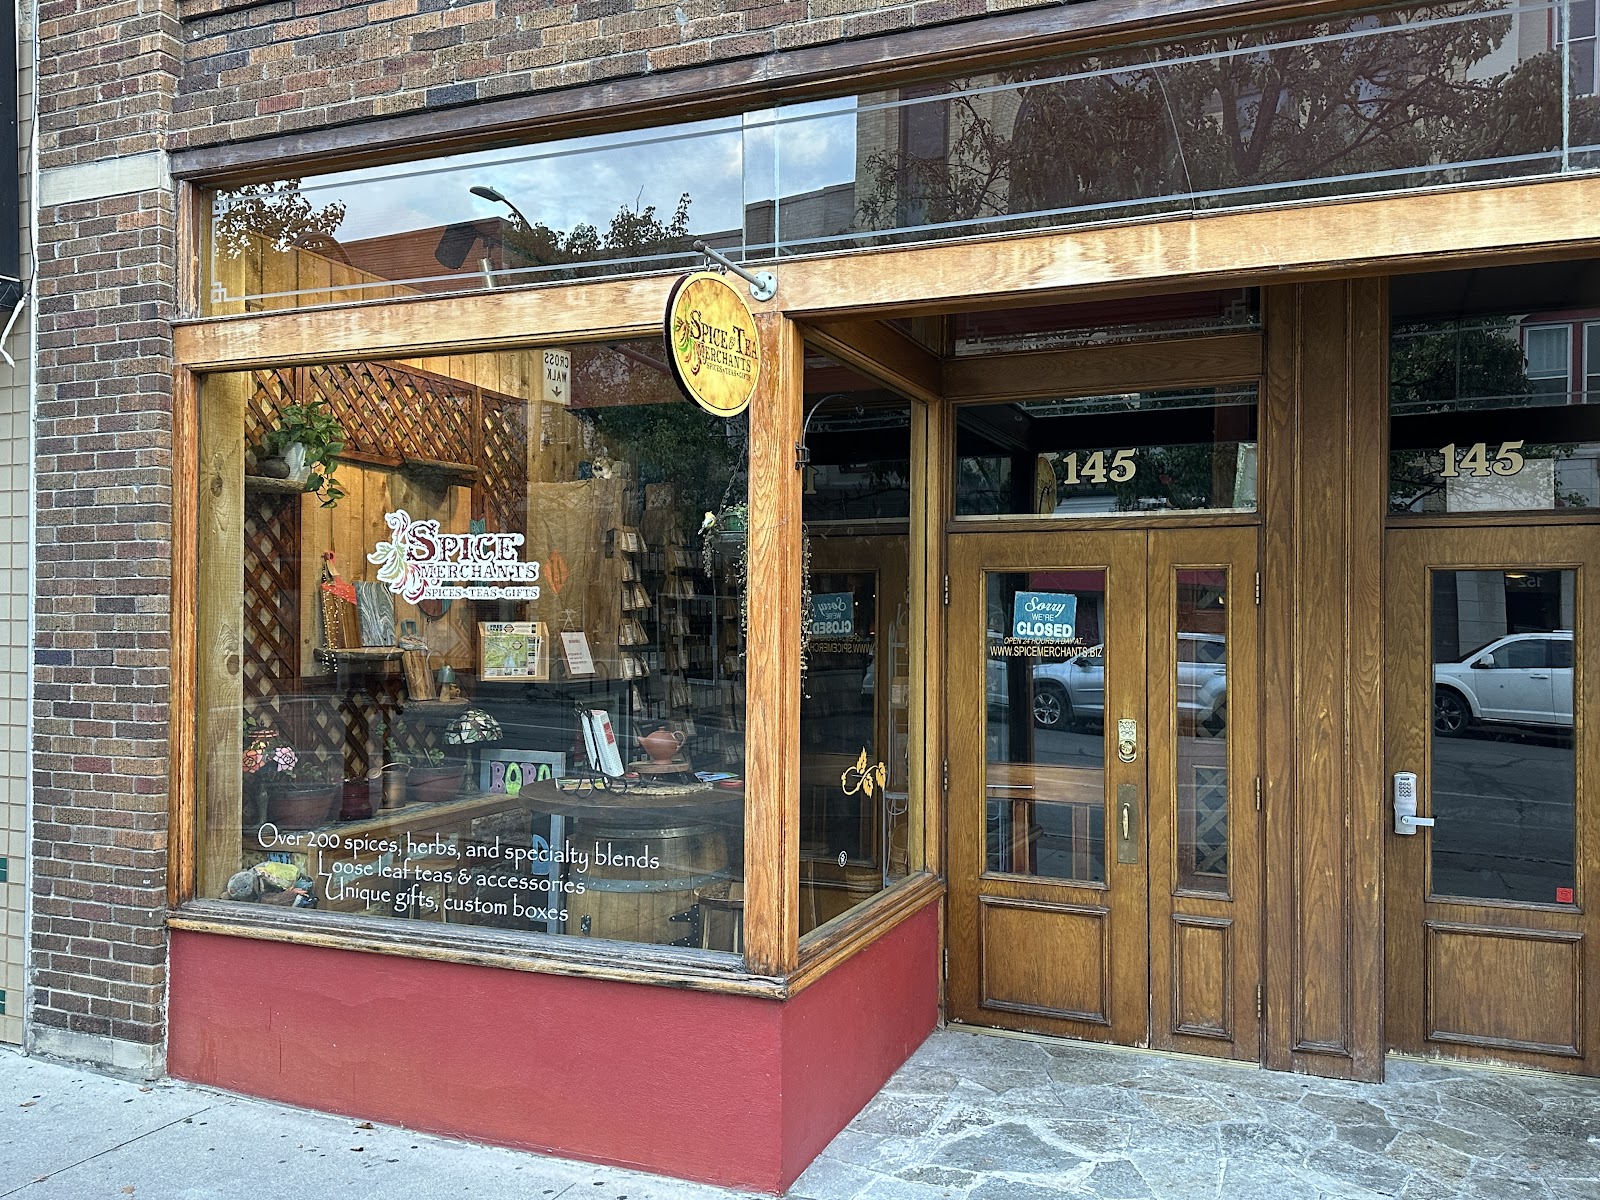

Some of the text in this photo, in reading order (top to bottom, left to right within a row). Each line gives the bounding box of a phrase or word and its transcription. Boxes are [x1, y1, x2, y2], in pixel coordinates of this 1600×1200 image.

[690, 310, 728, 349] SPICE
[733, 325, 758, 360] TEA
[699, 342, 752, 372] MERCHANTS
[1063, 447, 1137, 485] 145
[1439, 440, 1525, 477] 145
[406, 522, 517, 562] SPICE
[420, 563, 538, 580] MERCHANTS
[424, 588, 538, 598] SPICES TEAS GIFTS
[1024, 597, 1066, 618] Sorry
[1016, 621, 1073, 638] CLOSED
[1031, 613, 1054, 622] WE'RE
[990, 645, 1103, 658] WWW.SPICEMERCHANTS.BIZ
[1004, 637, 1022, 645] OPEN
[1022, 637, 1031, 645] 24
[1031, 637, 1055, 645] HOURS
[258, 822, 303, 848] Over
[307, 831, 340, 848] 200
[344, 834, 401, 860] spices,
[406, 831, 461, 860] herbs,
[465, 835, 500, 858] and
[504, 839, 589, 874] specialty
[594, 841, 660, 869] blends
[318, 850, 586, 895] Loose leaf teas & accessories
[325, 876, 569, 922] Unique gifts, custom boxes
